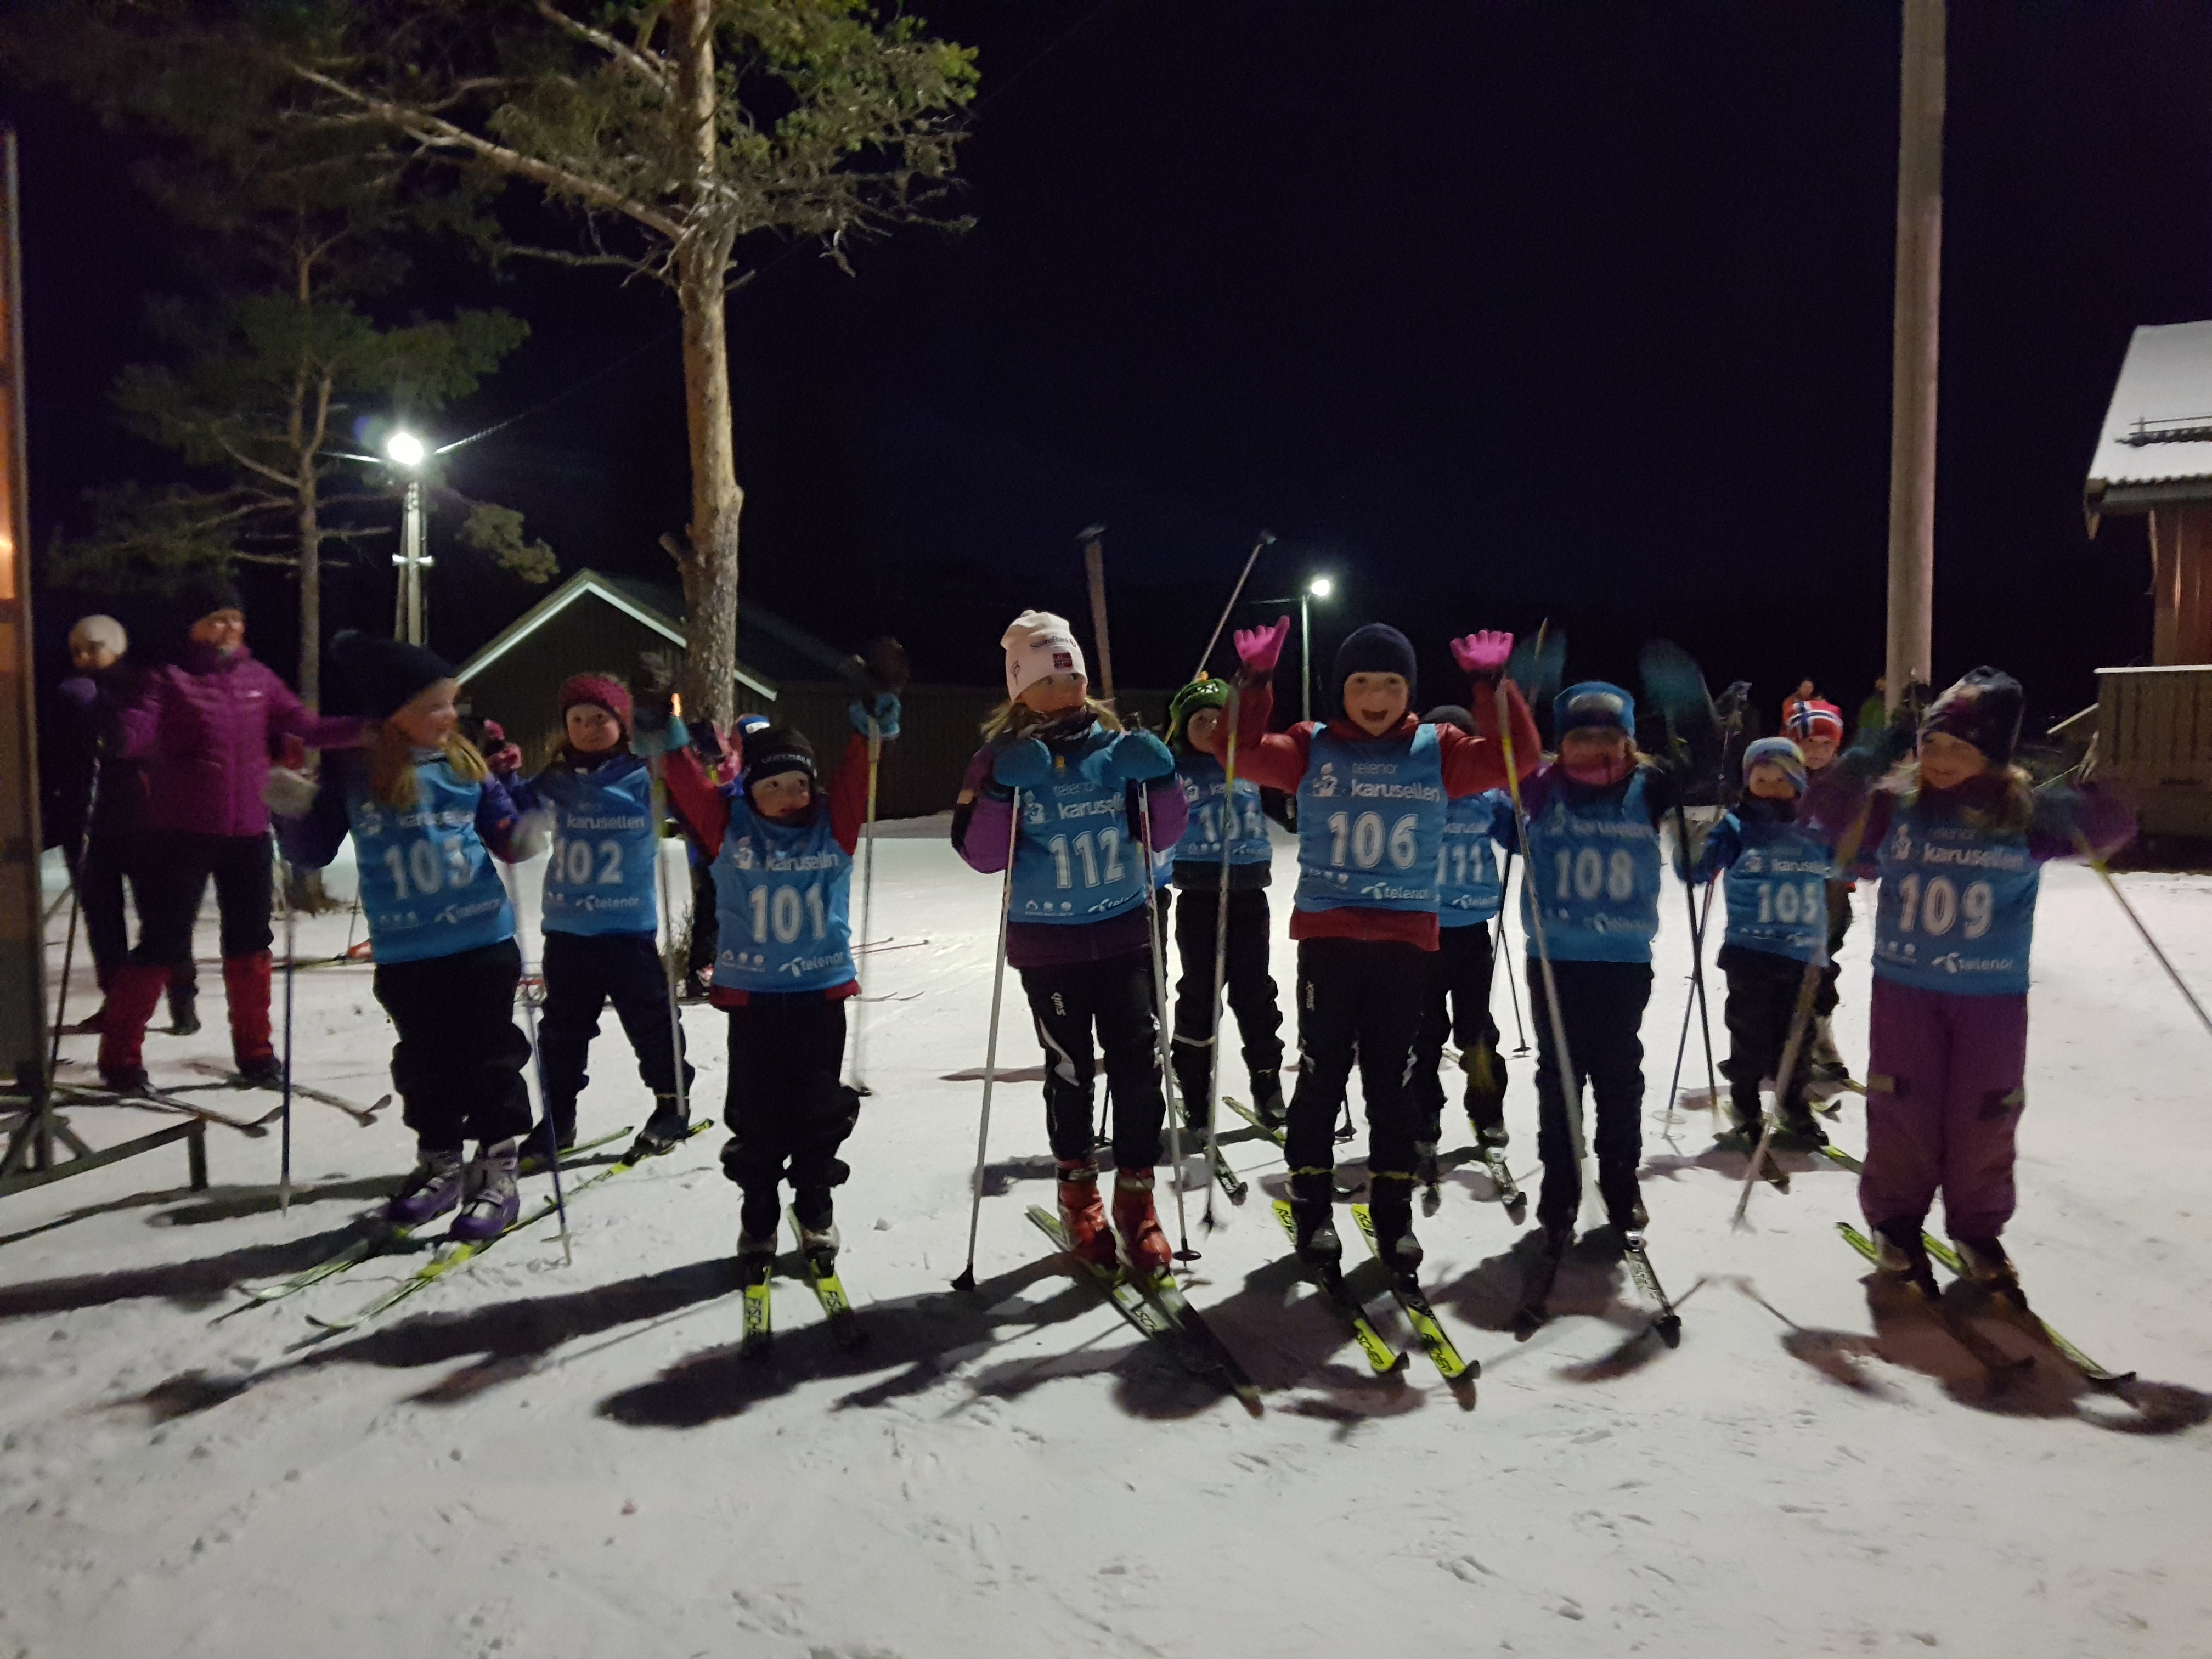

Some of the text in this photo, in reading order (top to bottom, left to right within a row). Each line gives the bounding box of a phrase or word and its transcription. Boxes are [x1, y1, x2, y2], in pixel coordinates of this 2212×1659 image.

[1351, 779, 1441, 803] karusellen
[554, 839, 624, 885] 102
[1048, 826, 1126, 889] 112
[1327, 811, 1419, 870] 106
[1434, 842, 1483, 885] 111
[1555, 847, 1634, 901] 108
[749, 882, 826, 944] 101
[1757, 881, 1820, 924] 105
[1899, 873, 1994, 939] 109
[800, 951, 845, 972] telenor
